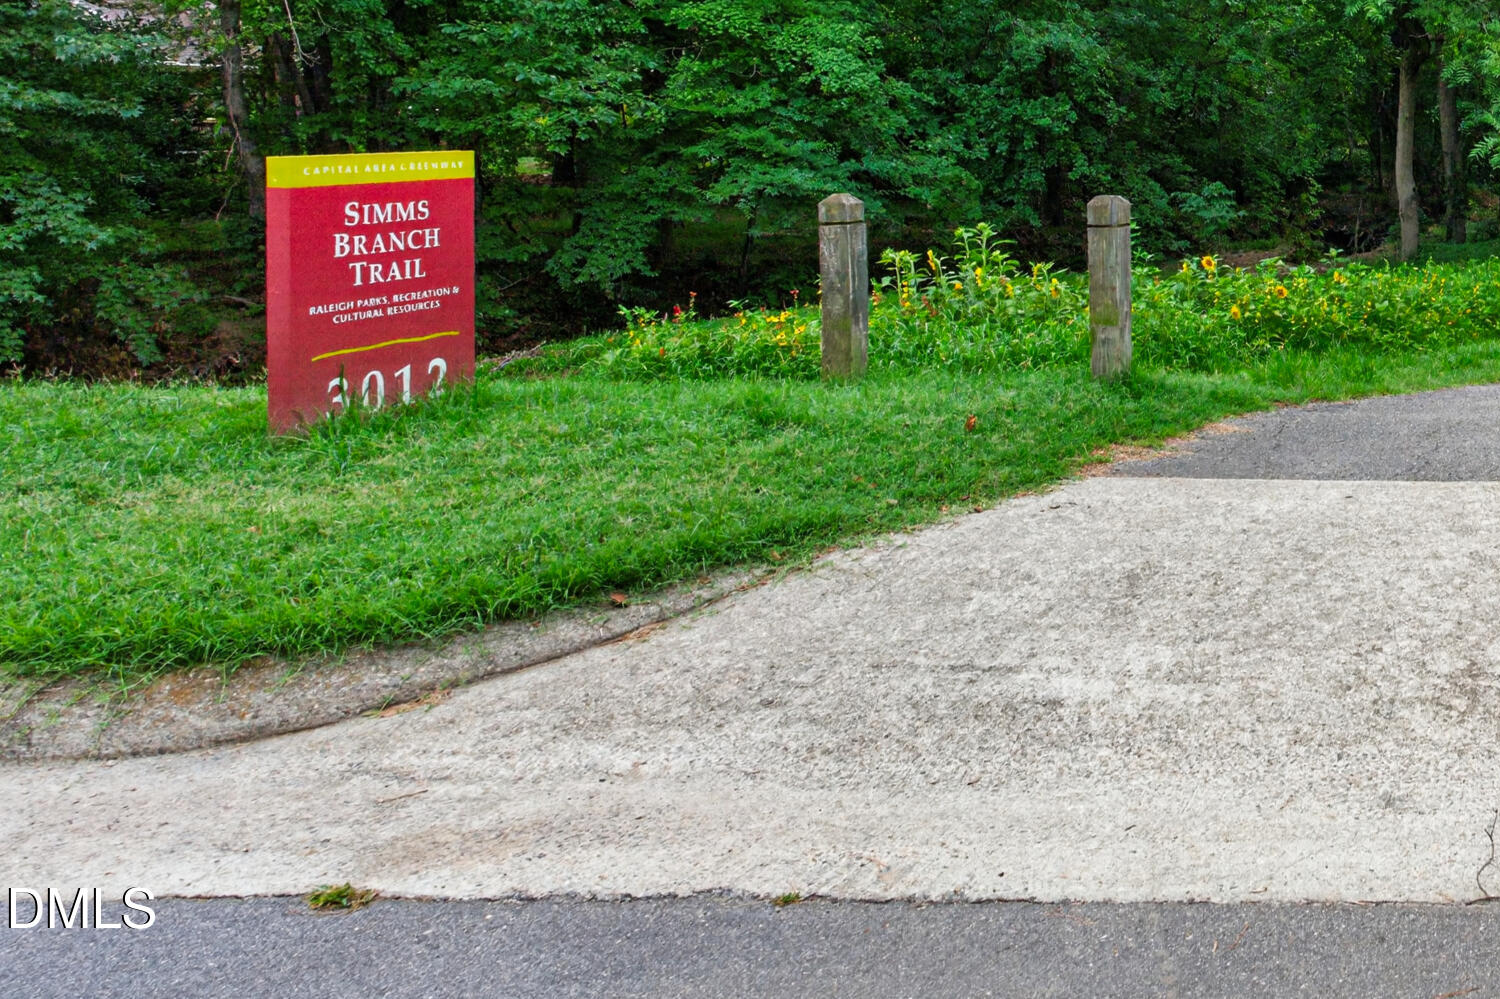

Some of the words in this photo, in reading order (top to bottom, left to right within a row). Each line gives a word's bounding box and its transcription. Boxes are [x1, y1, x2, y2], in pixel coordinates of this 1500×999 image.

[344, 200, 430, 226] SIMMS
[333, 228, 441, 258] BRANCH
[349, 258, 426, 286] TRAIL
[309, 301, 354, 316] RALEIGH
[392, 286, 450, 303] RECREATION
[332, 309, 384, 324] CULTURAL
[387, 300, 441, 316] RESOURCES
